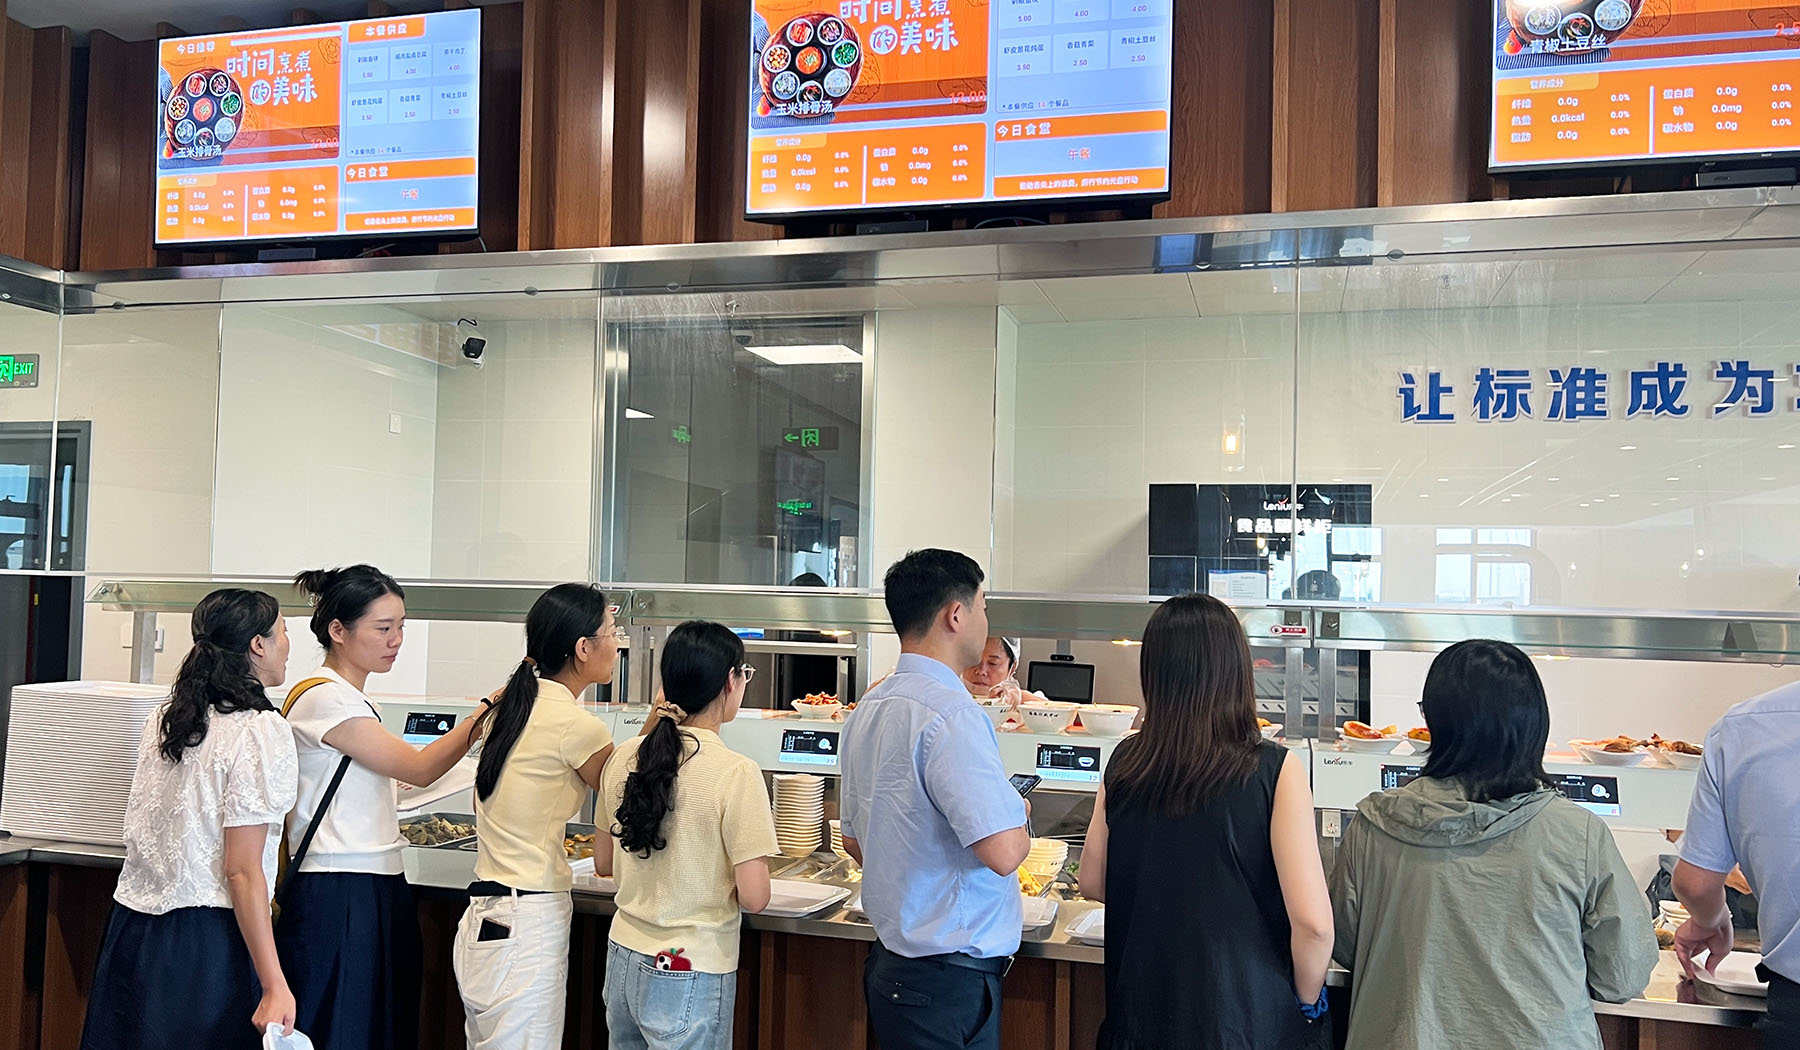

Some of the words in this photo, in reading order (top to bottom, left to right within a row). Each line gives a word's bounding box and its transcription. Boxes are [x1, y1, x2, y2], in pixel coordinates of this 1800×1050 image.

[869, 18, 959, 56] 的美味
[1530, 34, 1608, 54] 青椒土豆丝
[226, 49, 312, 78] 时间烹煮
[250, 73, 318, 106] 的美味
[1716, 87, 1738, 96] 0.0g
[1771, 84, 1792, 92] 0.0%
[1557, 97, 1579, 107] 0.0g
[1610, 93, 1631, 102] 0.0%
[776, 100, 834, 116] 玉米排骨汤
[1712, 104, 1742, 114] 0.0mg
[1771, 101, 1792, 109] 0.0%
[1551, 113, 1585, 123] 0.0kcal
[1610, 111, 1630, 119] 0.0%
[997, 122, 1051, 138] 今日食堂
[1716, 121, 1738, 131] 0.0g
[1771, 118, 1792, 127] 0.0%
[1557, 131, 1578, 140] 0.0g
[1610, 128, 1630, 136] 0.0%
[178, 145, 222, 158] 玉米排骨汤
[912, 146, 929, 156] 0.0g
[796, 153, 812, 163] 0.0g
[909, 161, 931, 171] 0.0mg
[14, 363, 34, 375] EXIT
[1397, 360, 1800, 423] 让标准成为
